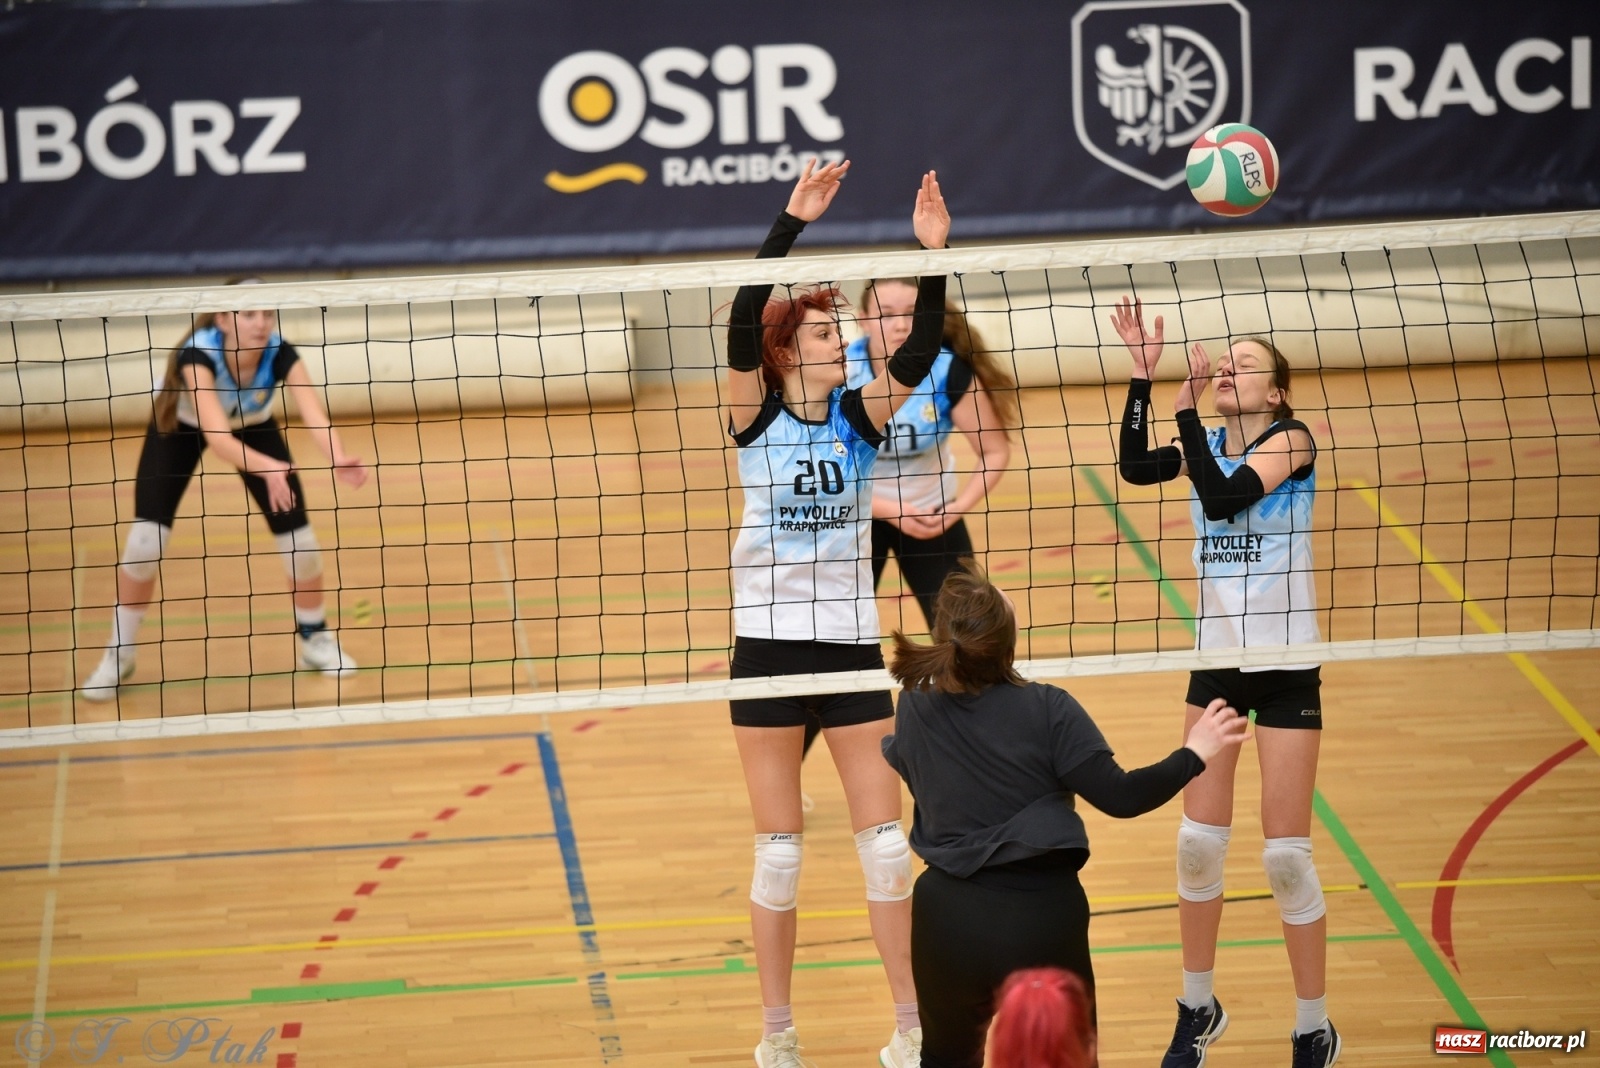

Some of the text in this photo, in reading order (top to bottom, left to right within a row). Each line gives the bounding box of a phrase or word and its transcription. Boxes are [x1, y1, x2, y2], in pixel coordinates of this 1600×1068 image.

[1354, 36, 1592, 122] RACI
[1239, 151, 1262, 189] RLPS
[1131, 398, 1142, 430] ALLSIX
[794, 459, 845, 496] 20
[779, 506, 798, 519] PV
[1211, 534, 1263, 551] VOLLEY
